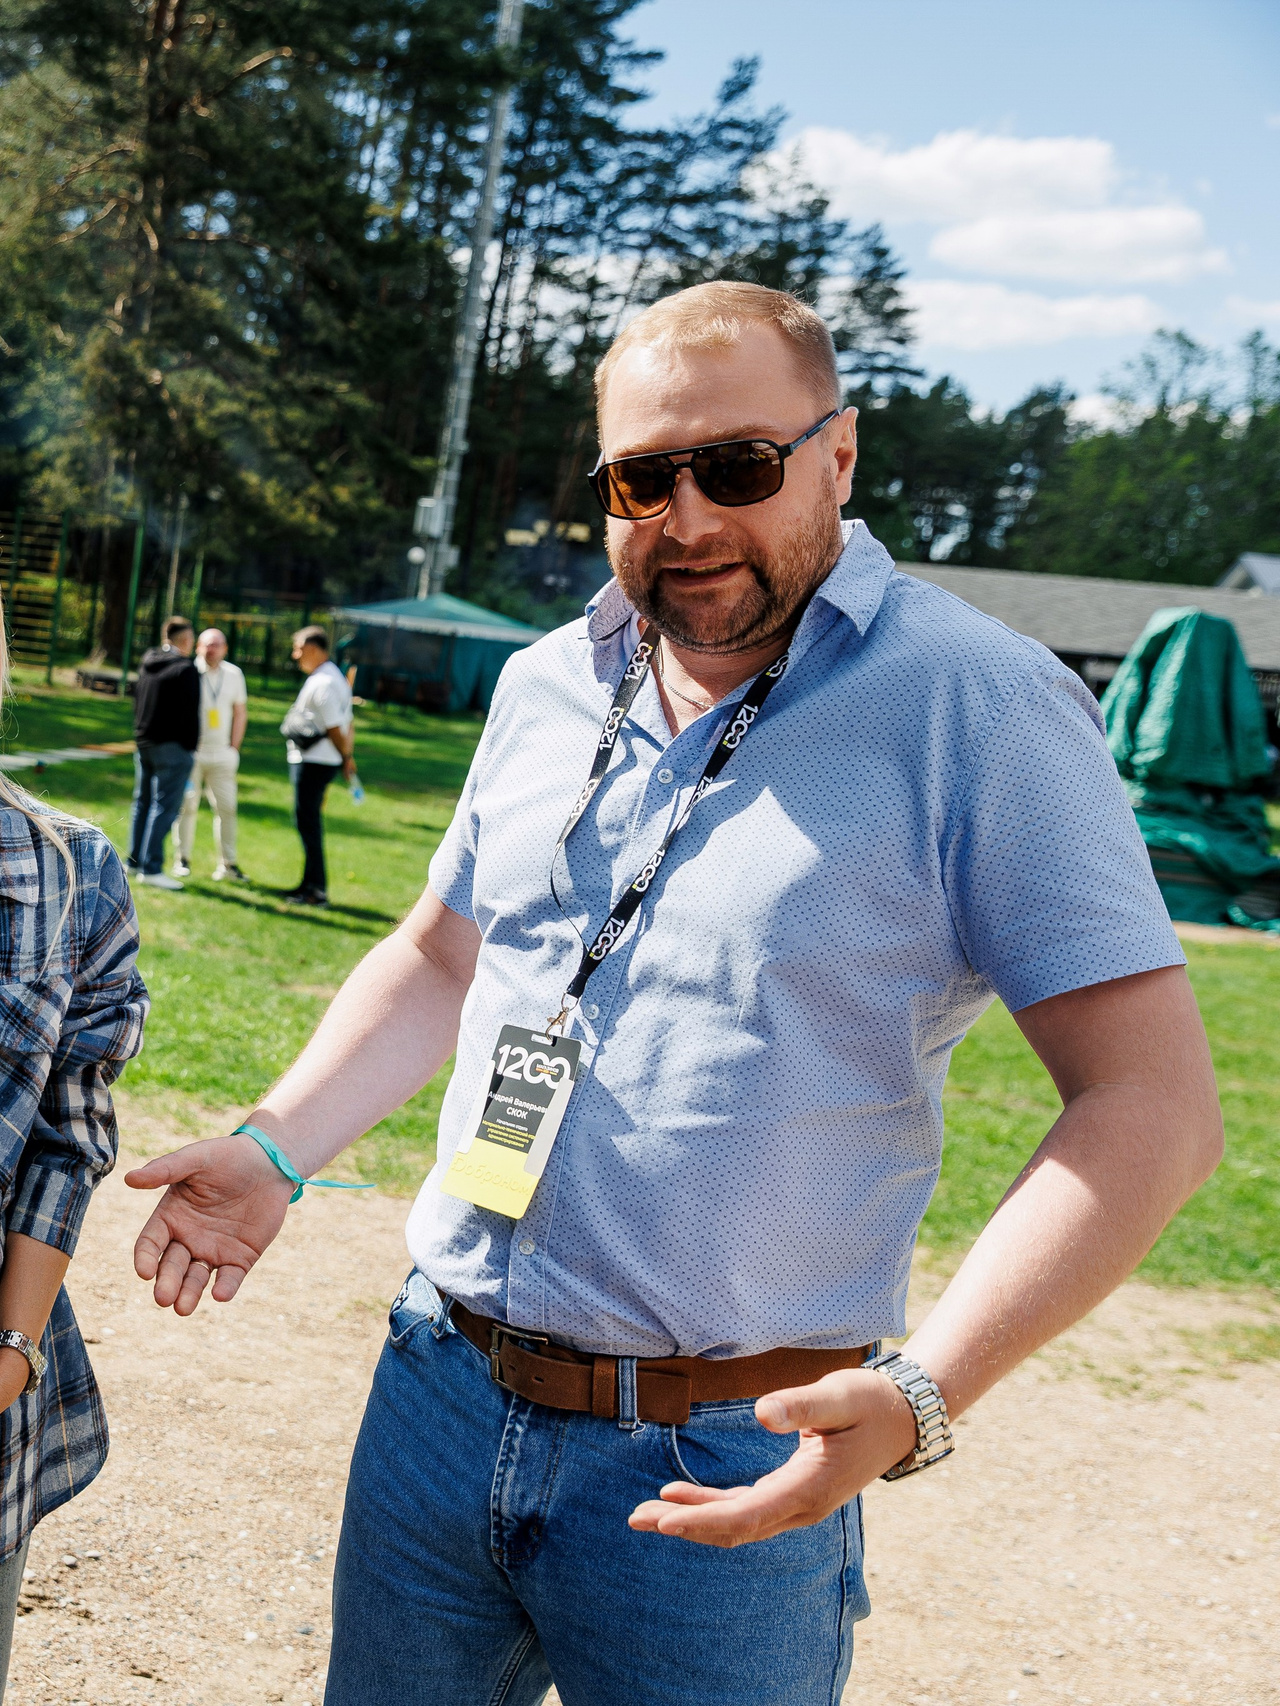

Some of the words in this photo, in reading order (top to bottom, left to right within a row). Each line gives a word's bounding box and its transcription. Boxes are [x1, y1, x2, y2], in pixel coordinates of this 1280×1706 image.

[624, 641, 653, 681] 1200
[766, 654, 789, 678] 00
[599, 707, 625, 750] 1200
[722, 703, 759, 750] 1200
[589, 917, 625, 961] 1200
[496, 1043, 571, 1090] 1200
[506, 1106, 528, 1120] СКОК
